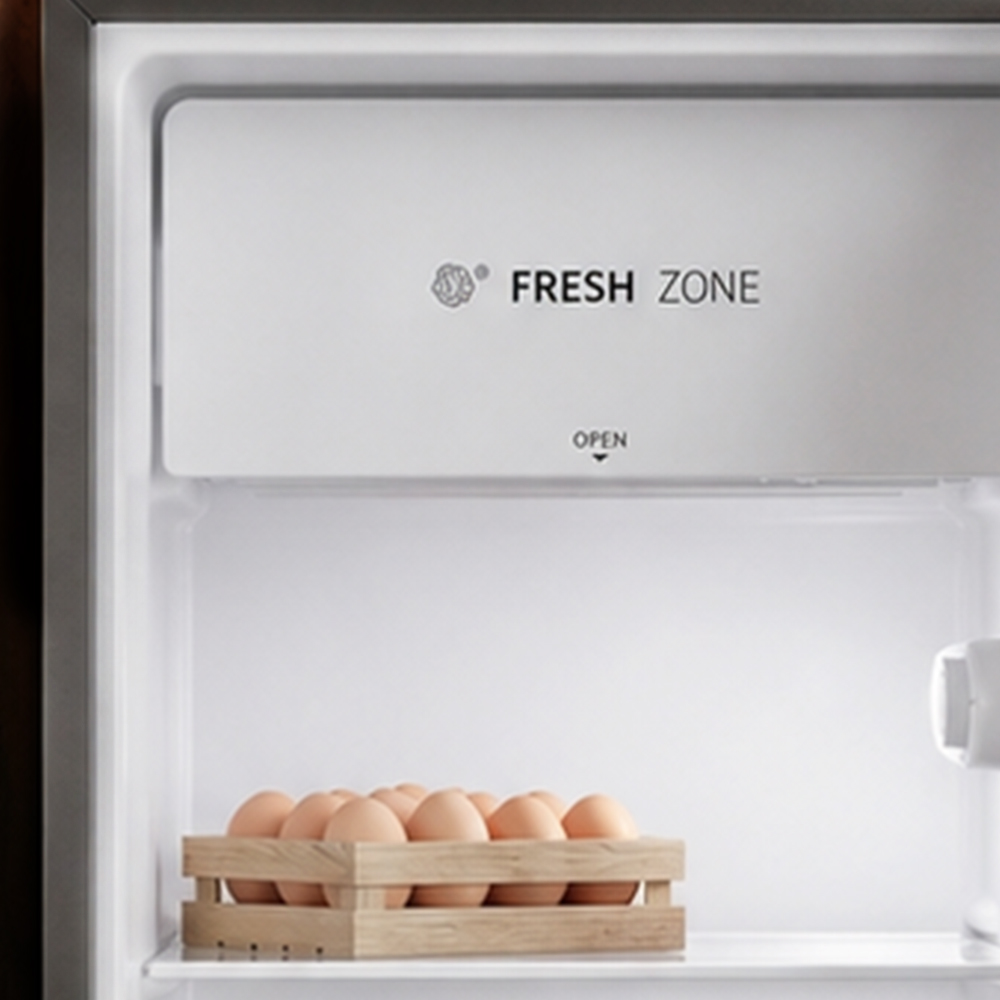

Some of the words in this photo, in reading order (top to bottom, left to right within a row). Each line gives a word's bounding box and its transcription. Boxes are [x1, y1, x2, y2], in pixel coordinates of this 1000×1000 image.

[511, 269, 635, 303] FRESH
[658, 269, 760, 304] ZONE
[572, 430, 628, 449] OPEN
